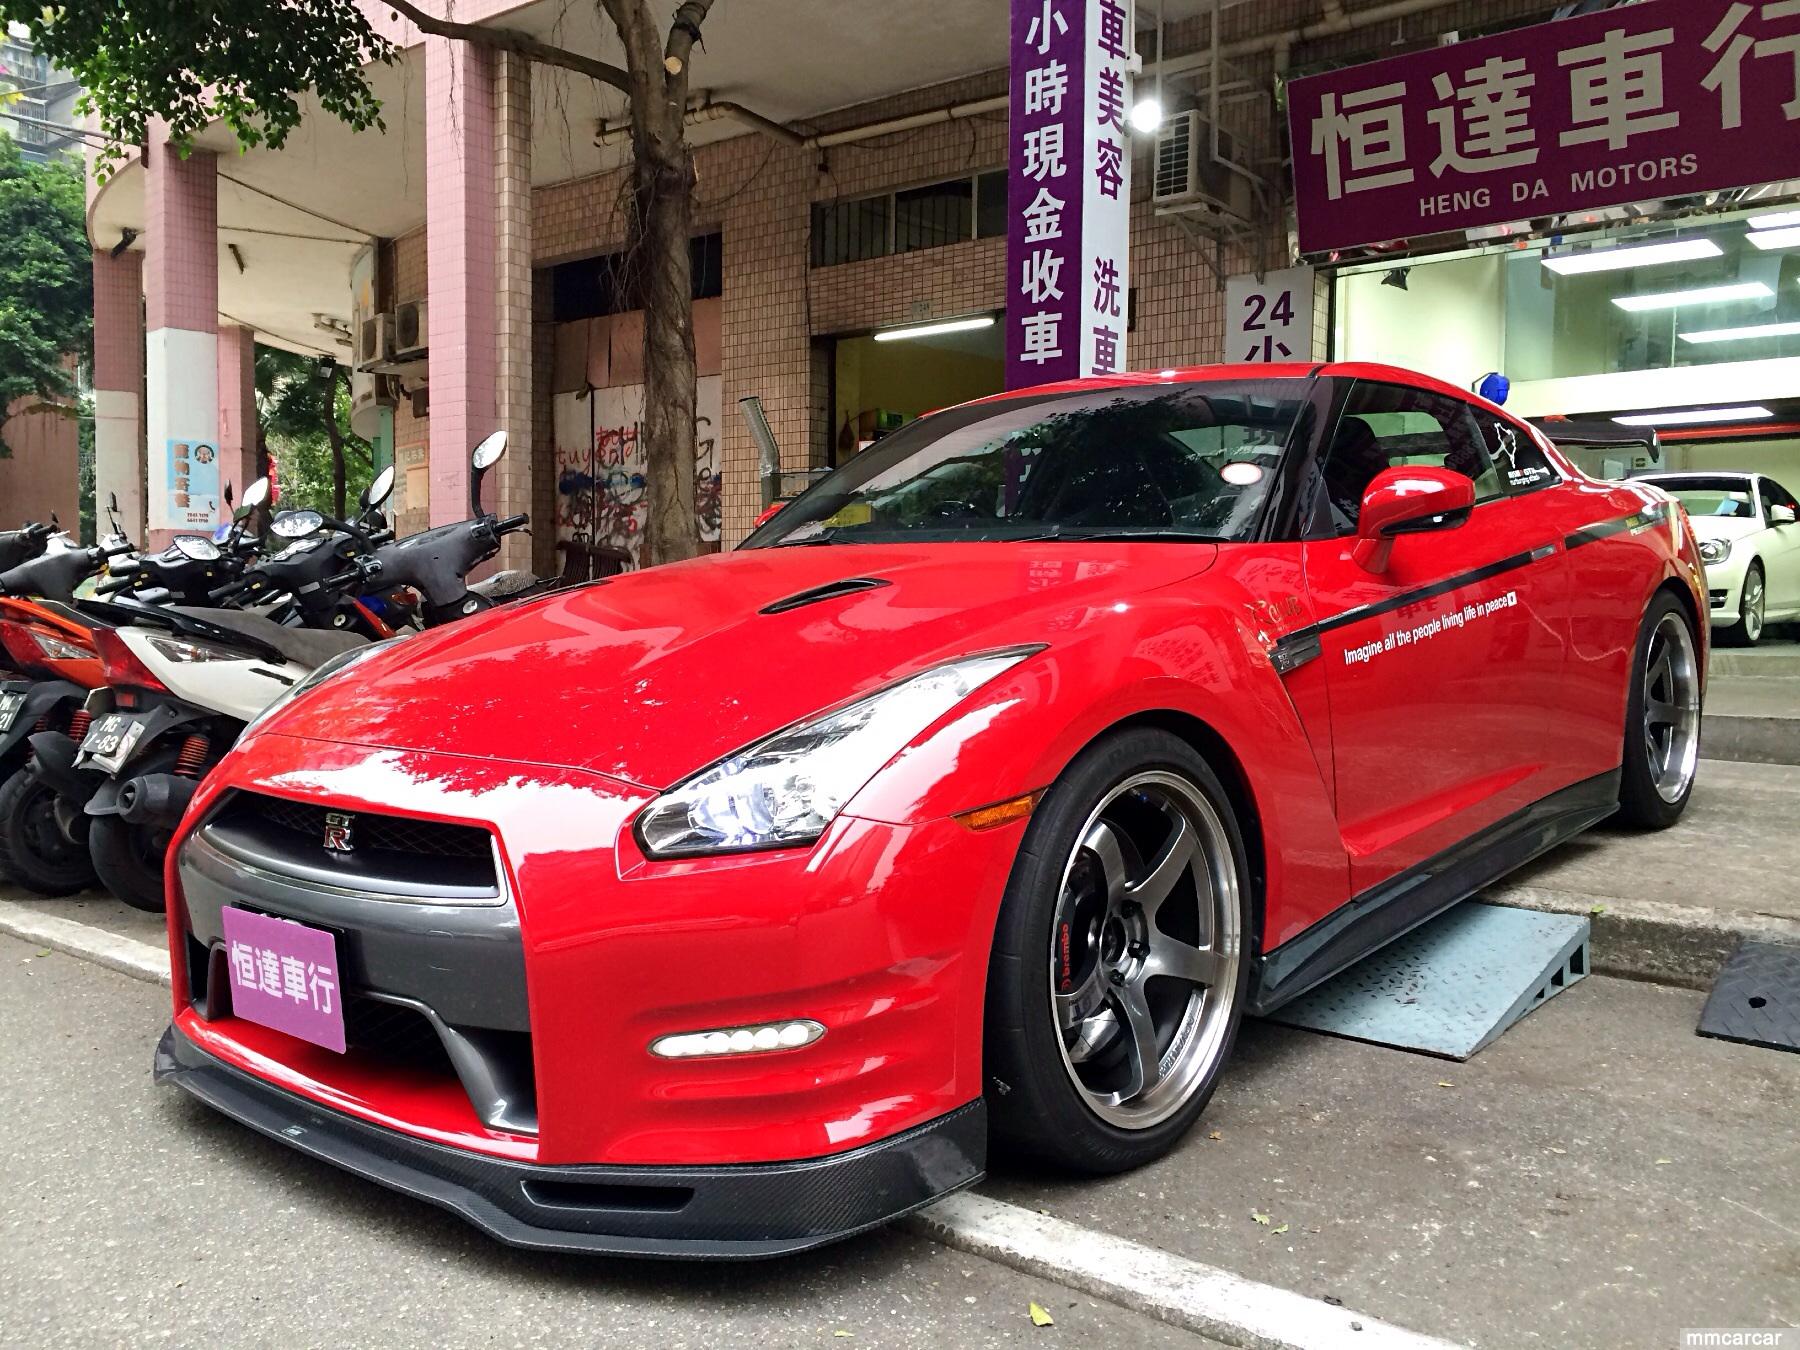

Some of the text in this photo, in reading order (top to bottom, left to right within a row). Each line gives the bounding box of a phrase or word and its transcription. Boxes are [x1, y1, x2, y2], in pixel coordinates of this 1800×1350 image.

[1311, 0, 1800, 200] 恒達車行
[1020, 0, 1069, 365] 小時現金收車
[1093, 0, 1126, 375] 車美容 洗車
[1420, 153, 1698, 217] HENG DA MOTORS
[1243, 290, 1295, 331] 24
[1344, 595, 1508, 666] Imagine all the people living life in peace
[231, 940, 335, 1014] 恒達車行
[1061, 922, 1071, 977] brembo
